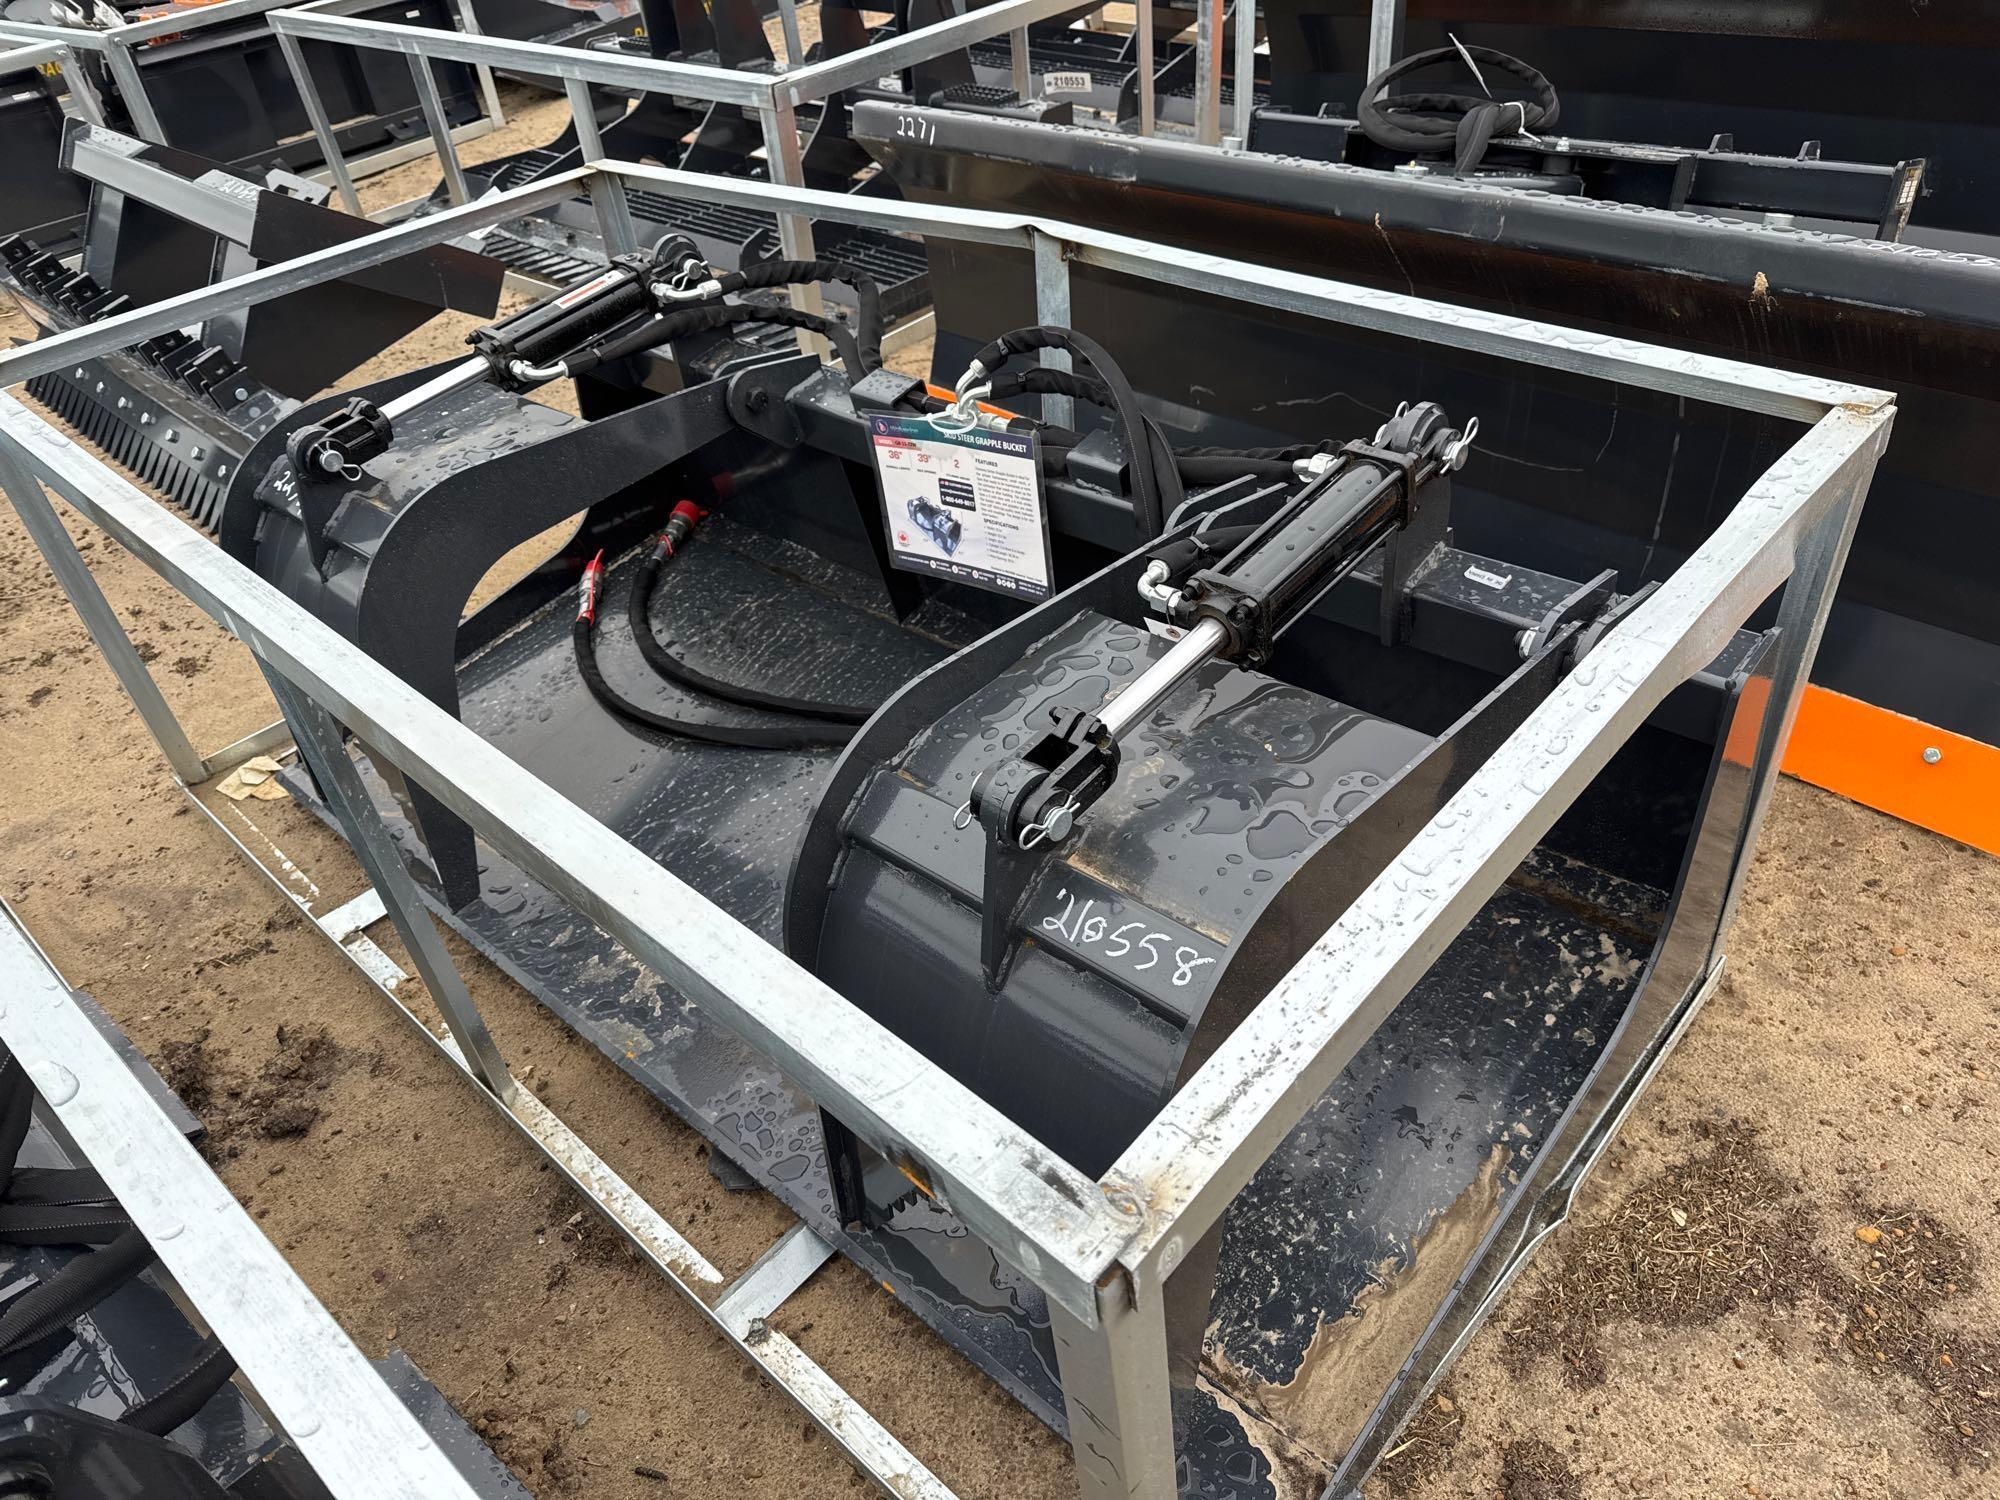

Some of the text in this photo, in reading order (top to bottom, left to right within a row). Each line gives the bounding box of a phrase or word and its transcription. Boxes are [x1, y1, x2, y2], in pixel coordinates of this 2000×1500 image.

[1053, 76, 1085, 87] 210553
[896, 115, 936, 146] 2271
[957, 433, 975, 444] STEER
[975, 437, 1002, 449] GRAPPLE
[1002, 441, 1027, 453] BUCKET
[953, 459, 960, 469] 2
[975, 458, 998, 468] FEATURES
[983, 517, 1019, 531] SPECIFICATIONS
[1042, 888, 1216, 986] 210558
